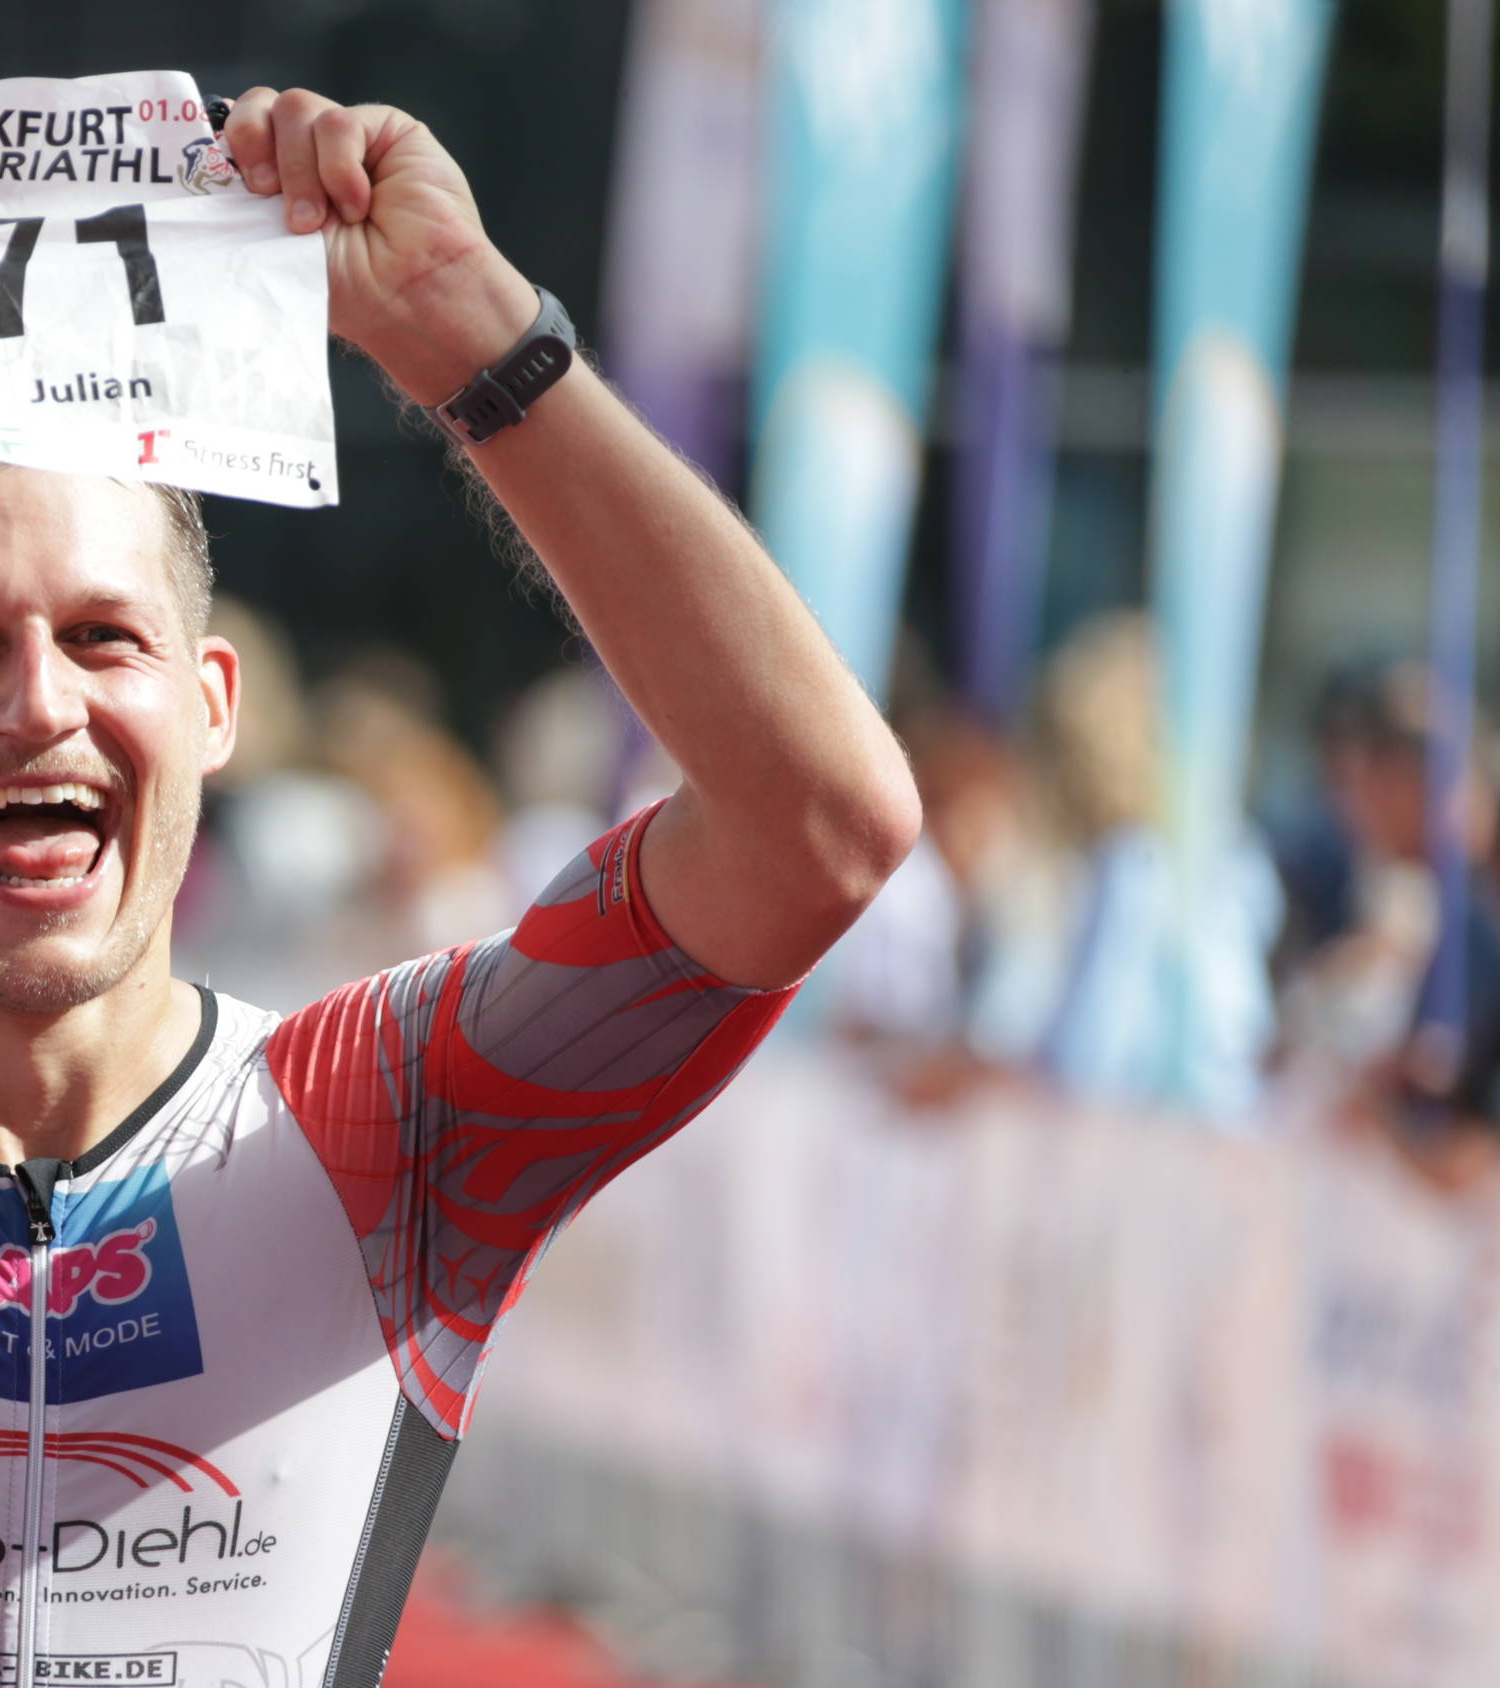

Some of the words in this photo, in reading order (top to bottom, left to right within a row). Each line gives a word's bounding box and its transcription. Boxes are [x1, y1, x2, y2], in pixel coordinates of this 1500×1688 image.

[31, 372, 153, 404] Julian
[268, 452, 316, 480] First
[65, 1312, 162, 1359] MODE
[43, 1582, 177, 1603] Innovation.
[185, 1572, 268, 1596] Service.
